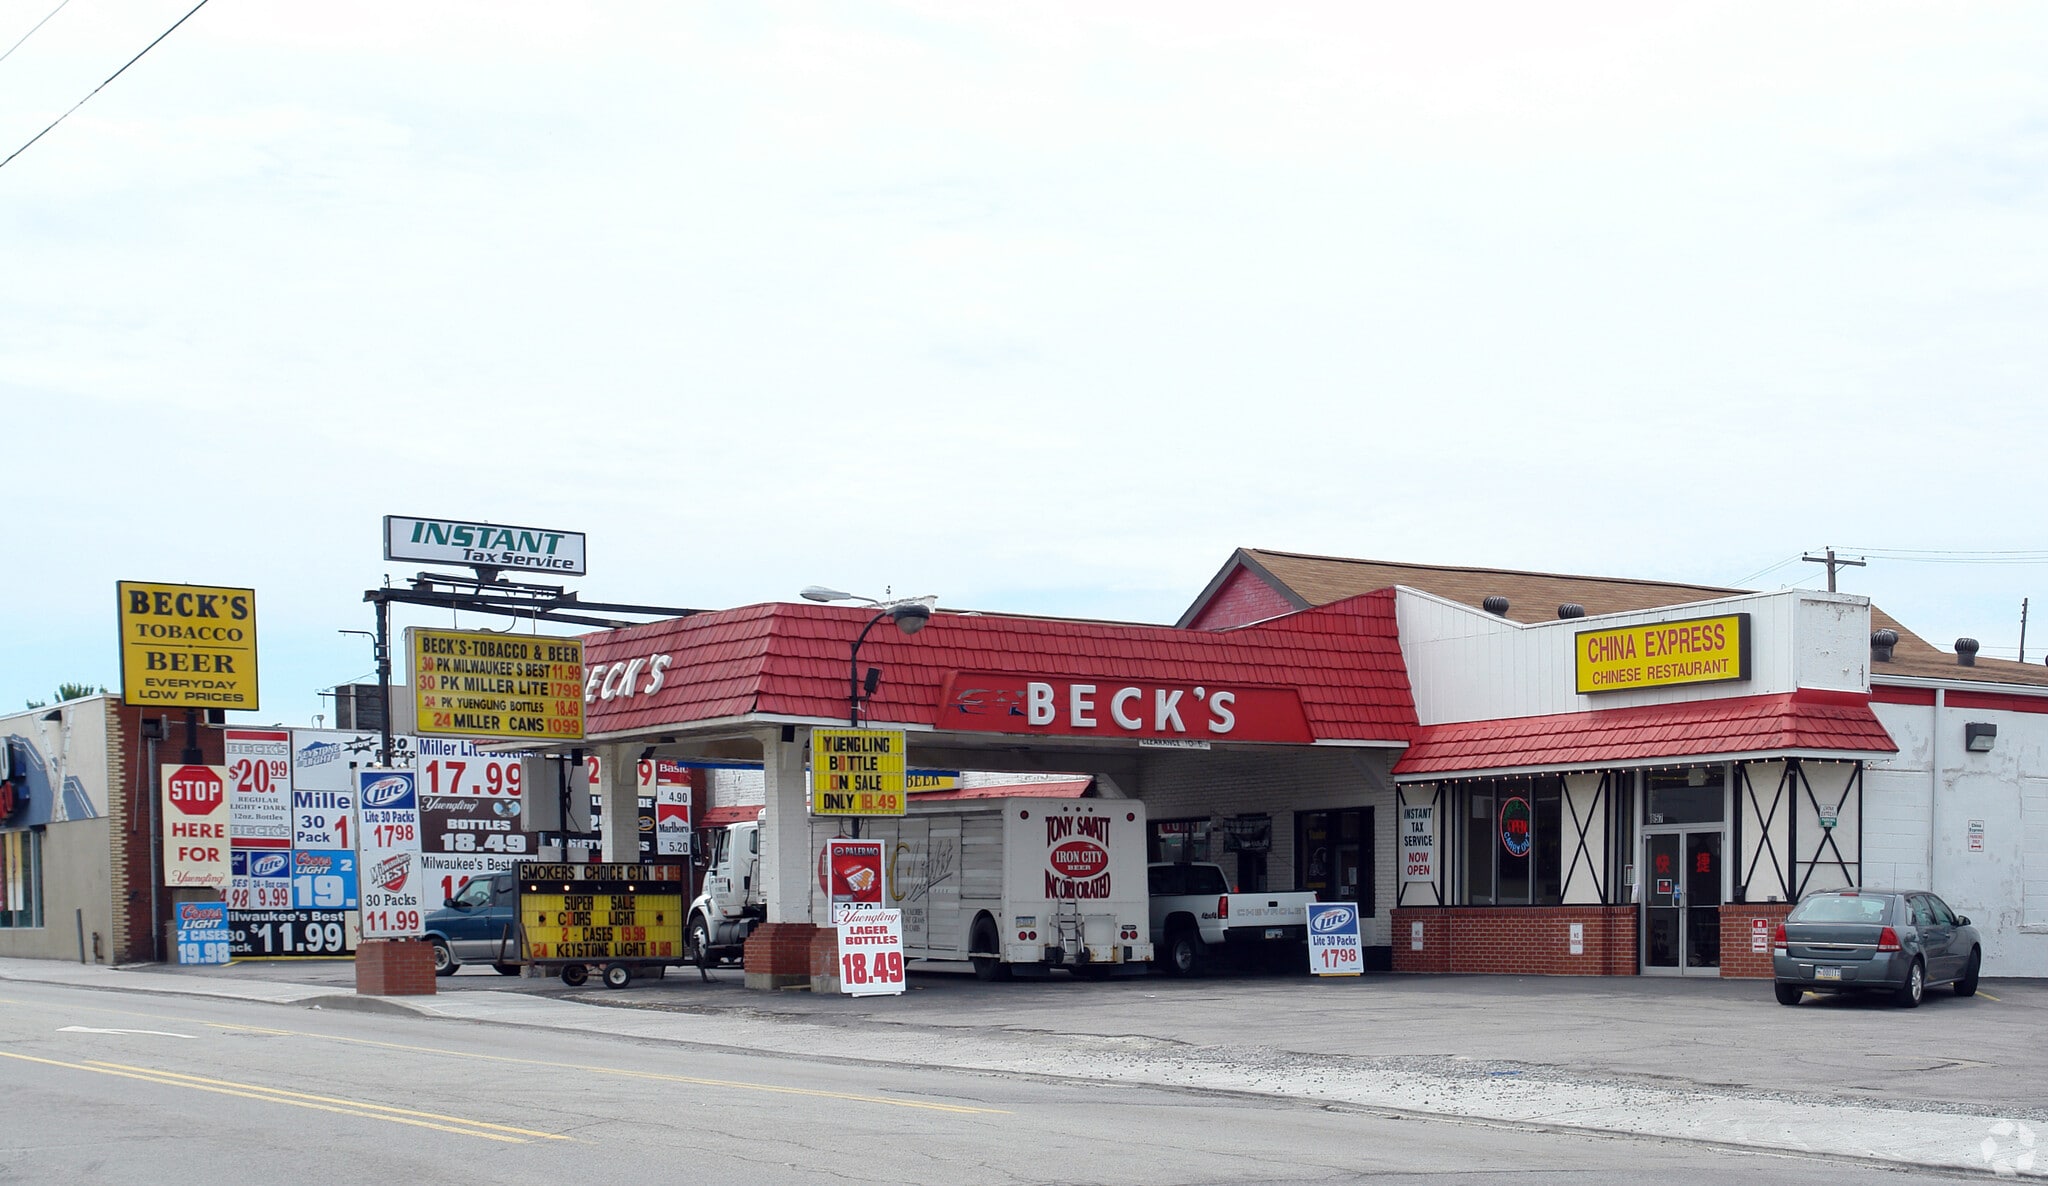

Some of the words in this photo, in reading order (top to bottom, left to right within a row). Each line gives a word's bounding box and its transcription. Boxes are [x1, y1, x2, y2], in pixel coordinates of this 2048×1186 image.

[411, 522, 565, 555] INSTANT
[463, 549, 497, 563] Tax
[500, 552, 574, 569] Service
[129, 590, 248, 620] BECK'S
[136, 624, 243, 641] TOBACCO
[1588, 635, 1637, 664] CHINA
[1645, 623, 1726, 657] EXPRESS
[534, 645, 542, 660] &
[550, 647, 578, 662] BEER
[146, 652, 236, 673] BEER
[422, 656, 434, 672] 30
[437, 658, 450, 672] PK
[526, 664, 550, 678] BEST
[552, 664, 582, 680] 11.99
[1592, 667, 1641, 685] CHINESE
[1647, 658, 1729, 680] RESTAURANT
[145, 678, 237, 689] EVERYDAY
[420, 675, 435, 690] 30
[441, 676, 460, 690] PK
[464, 678, 514, 694] MILLER
[518, 681, 548, 696] LITE
[550, 682, 582, 698] 1798
[139, 690, 178, 699] LOW
[185, 692, 244, 702] PRICES
[424, 696, 435, 707] 24
[442, 697, 453, 708] PK
[456, 698, 506, 712] YUENGLING
[510, 700, 544, 712] BOTTLES
[555, 702, 578, 716] 18.49
[1027, 682, 1236, 733] BECK'S
[433, 712, 451, 728] 24
[454, 713, 500, 730] MILLER
[509, 717, 544, 732] CANS
[547, 719, 580, 733] 1099
[226, 742, 288, 755] BECK'S
[420, 739, 457, 756] Miller
[823, 736, 890, 753] YUENGLING
[830, 756, 878, 771] BOTTLE
[426, 760, 521, 795] 17.99
[830, 774, 848, 790] ON
[855, 775, 882, 790] SALE
[172, 780, 220, 801] STOP
[373, 782, 405, 803] Lite
[669, 792, 688, 803] 4.90
[294, 792, 354, 809] Mille
[420, 797, 479, 812] Yuengling
[824, 794, 854, 809] ONLY
[861, 794, 897, 809] 18.49
[365, 812, 378, 822] Lite
[380, 812, 390, 822] 30
[392, 812, 414, 823] Packs
[1404, 808, 1432, 819] INSTANT
[301, 815, 325, 828] 30
[446, 818, 511, 830] BOTTLES
[658, 821, 689, 833] Marlboro
[1411, 822, 1424, 832] TAX
[1507, 820, 1528, 834] OPEN
[172, 822, 224, 838] HERE
[230, 824, 290, 837] BECK'S
[296, 832, 331, 842] Pack
[1045, 816, 1074, 848] TONY
[440, 832, 526, 852] 18.49
[670, 842, 688, 852] 5.20
[1404, 835, 1432, 847] SERVICE
[1504, 832, 1520, 854] CARRY
[178, 847, 221, 862] FOR
[296, 851, 332, 866] Coors
[845, 846, 878, 856] PALERMO
[1056, 850, 1080, 863] IRON
[1082, 850, 1102, 863] CITY
[1408, 852, 1428, 862] NOW
[260, 860, 282, 873] Lite
[296, 866, 331, 875] LIGHT
[340, 859, 352, 872] 2
[421, 856, 483, 870] Milwaukee's
[488, 858, 511, 871] Best
[1407, 865, 1430, 876] OPEN
[172, 870, 225, 884] Yuengling
[377, 864, 410, 887] BEST
[522, 865, 575, 880] SMOKERS
[584, 865, 624, 880] CHOICE
[627, 865, 650, 880] CTN
[258, 888, 288, 906] 9.99
[294, 875, 356, 907] 19.
[366, 894, 380, 906] 30
[384, 894, 417, 906] Packs
[564, 896, 594, 910] SUPER
[611, 896, 635, 910] SALE
[181, 904, 223, 920] Coors
[229, 911, 308, 922] ilwaukee's
[312, 912, 345, 922] Best
[558, 912, 592, 926] COORS
[608, 912, 635, 926] LIGHT
[838, 910, 900, 924] Yuengling
[182, 920, 222, 929] LIGHT
[366, 910, 420, 931] 11.99
[1320, 914, 1346, 930] Lite
[178, 931, 187, 942] 2
[190, 930, 229, 942] CASES
[562, 928, 568, 942] 2
[582, 928, 613, 941] CASES
[622, 928, 646, 941] 19.98
[850, 926, 888, 934] LAGER
[229, 943, 253, 952] ack
[845, 936, 898, 945] BOTTLES
[1313, 936, 1326, 946] Lite
[1327, 936, 1336, 946] 30
[1336, 936, 1357, 946] Packs
[178, 942, 230, 964] 19.98
[534, 944, 548, 958] 24
[556, 943, 610, 957] KEYSTONE
[614, 943, 646, 957] LIGHT
[650, 942, 656, 956] 9
[842, 952, 904, 984] 18.49
